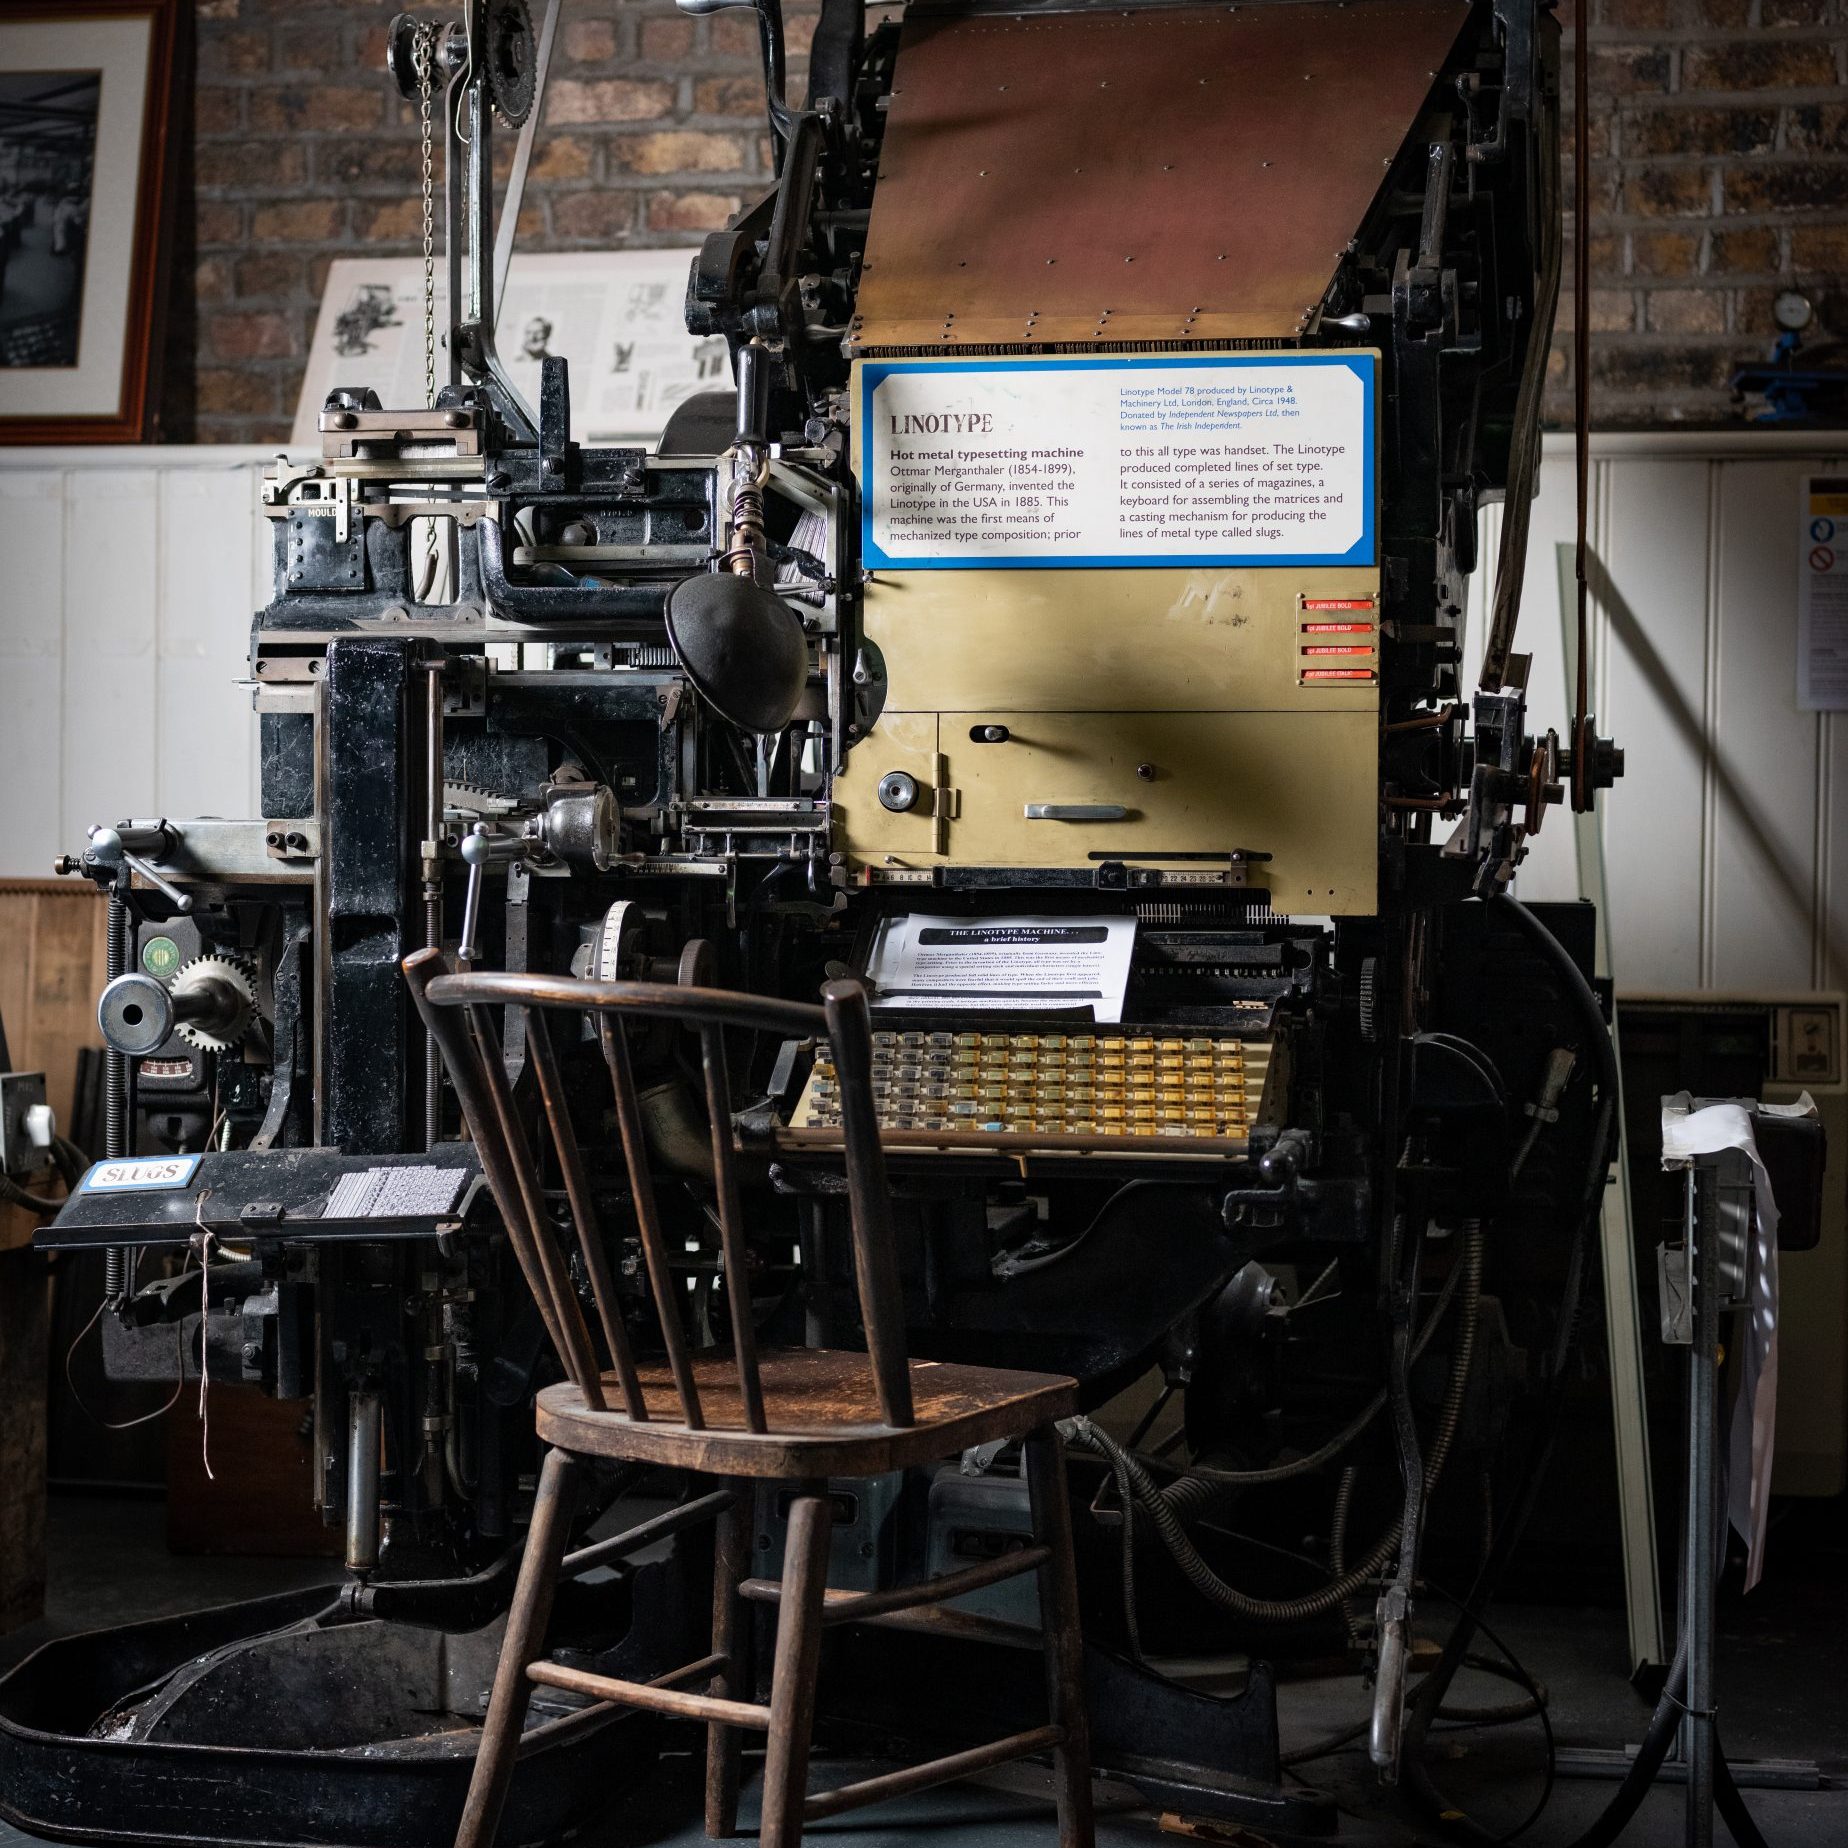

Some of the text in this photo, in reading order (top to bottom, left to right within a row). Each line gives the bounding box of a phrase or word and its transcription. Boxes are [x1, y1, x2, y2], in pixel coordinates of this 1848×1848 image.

[1120, 384, 1294, 398] Linotype Model 78 produced by Linotype &
[1120, 399, 1162, 410] Machinery
[1251, 397, 1274, 406] Circa
[1120, 411, 1155, 420] Donated
[1157, 410, 1167, 421] by
[1168, 410, 1215, 420] Independent
[1216, 409, 1263, 420] Newspapers
[1281, 408, 1300, 417] then
[890, 414, 993, 434] LINOTYPE
[1120, 423, 1147, 431] known
[1160, 422, 1175, 430] The
[1176, 422, 1193, 430] Irish
[890, 447, 1084, 462] Hot metal typesetting machine
[1120, 443, 1345, 459] to this all type was handset. The Linotype
[890, 465, 931, 477] Ottmar
[934, 464, 1005, 478] Merganthaler
[1120, 460, 1323, 476] produced completed lines of set type.
[890, 480, 1075, 496] originally of Germany, invented the
[1120, 479, 1128, 490] It
[1131, 478, 1181, 490] consisted
[1184, 478, 1196, 489] of
[1198, 480, 1205, 489] a
[1208, 478, 1240, 489] series
[1242, 477, 1255, 488] of
[1257, 477, 1315, 491] magazines,
[890, 496, 1069, 512] Linotype in the USA in 1885. This
[1120, 493, 1343, 508] keyboard for assembling the matrices and
[890, 512, 1056, 524] machine was the first means of
[1119, 509, 1327, 525] a casting mechanism for producing the
[890, 529, 1082, 543] mechanized type composition; prior
[1120, 526, 1284, 541] lines of metal type called slugs.
[103, 1164, 180, 1182] SLUGS
